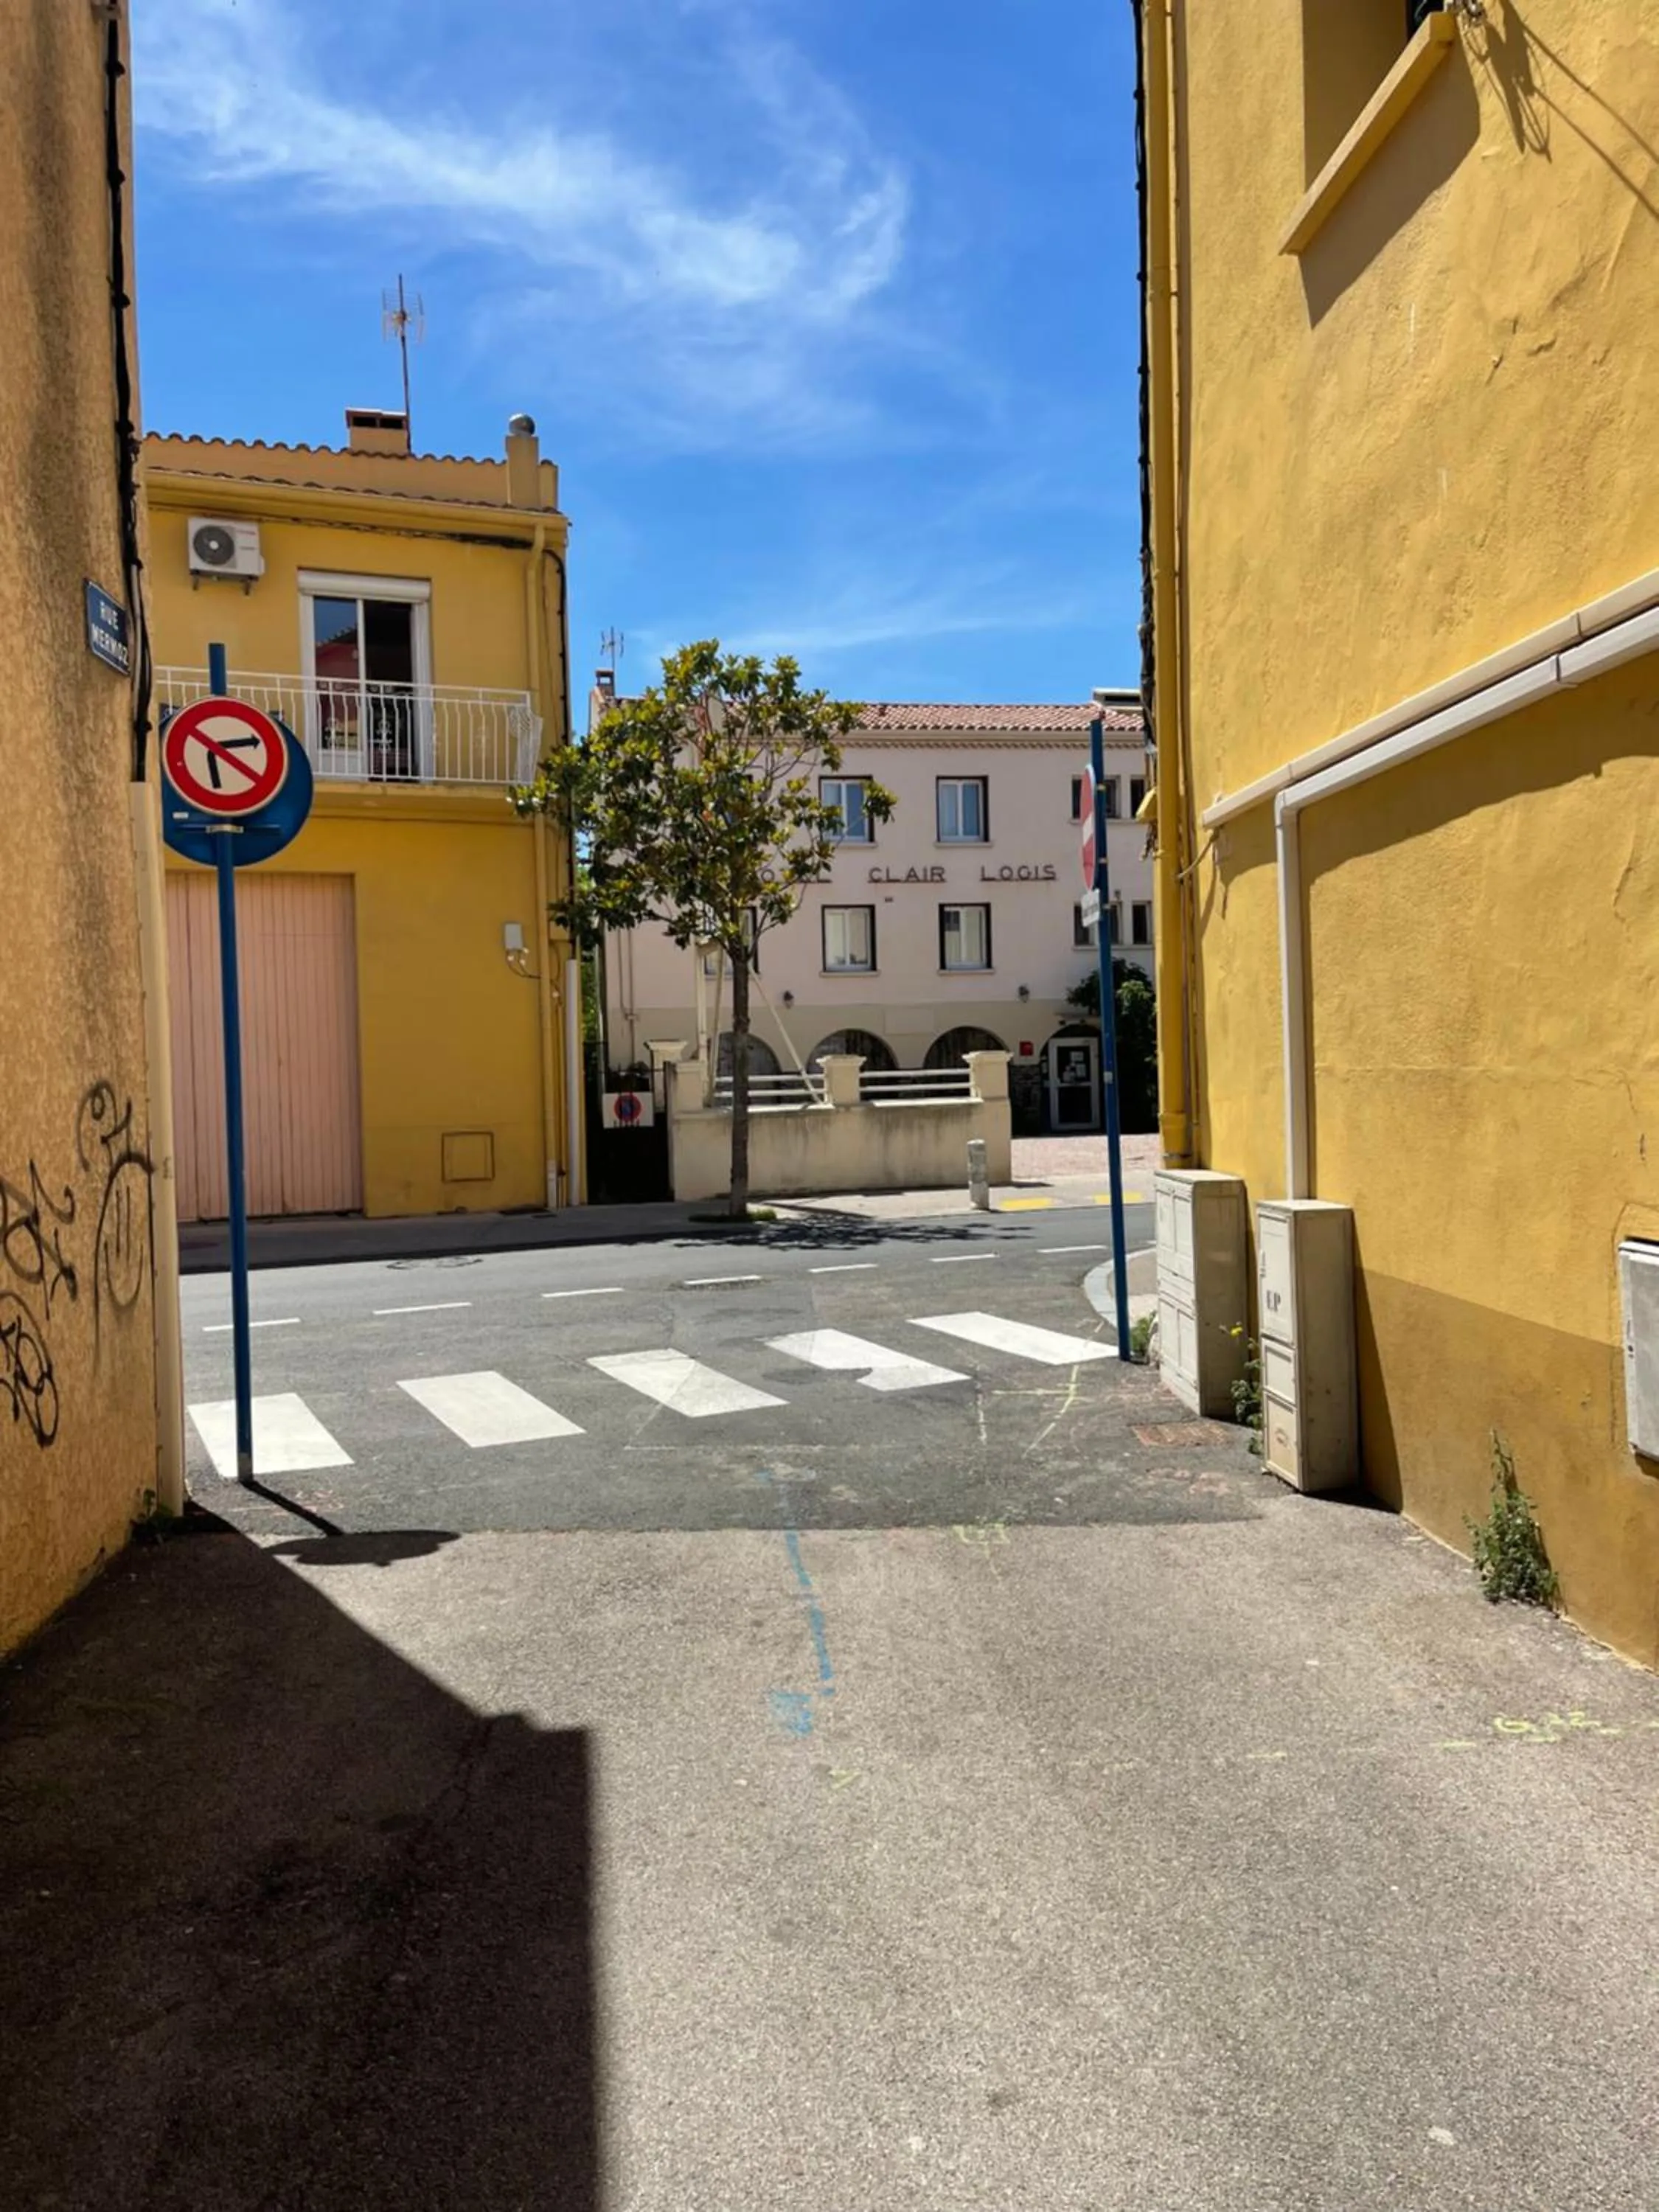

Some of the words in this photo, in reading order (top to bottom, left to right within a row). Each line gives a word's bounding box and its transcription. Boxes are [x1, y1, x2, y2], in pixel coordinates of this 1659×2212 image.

[100, 601, 119, 630] RUE
[869, 866, 946, 883] CLAIR
[980, 864, 1057, 881] LOGIS
